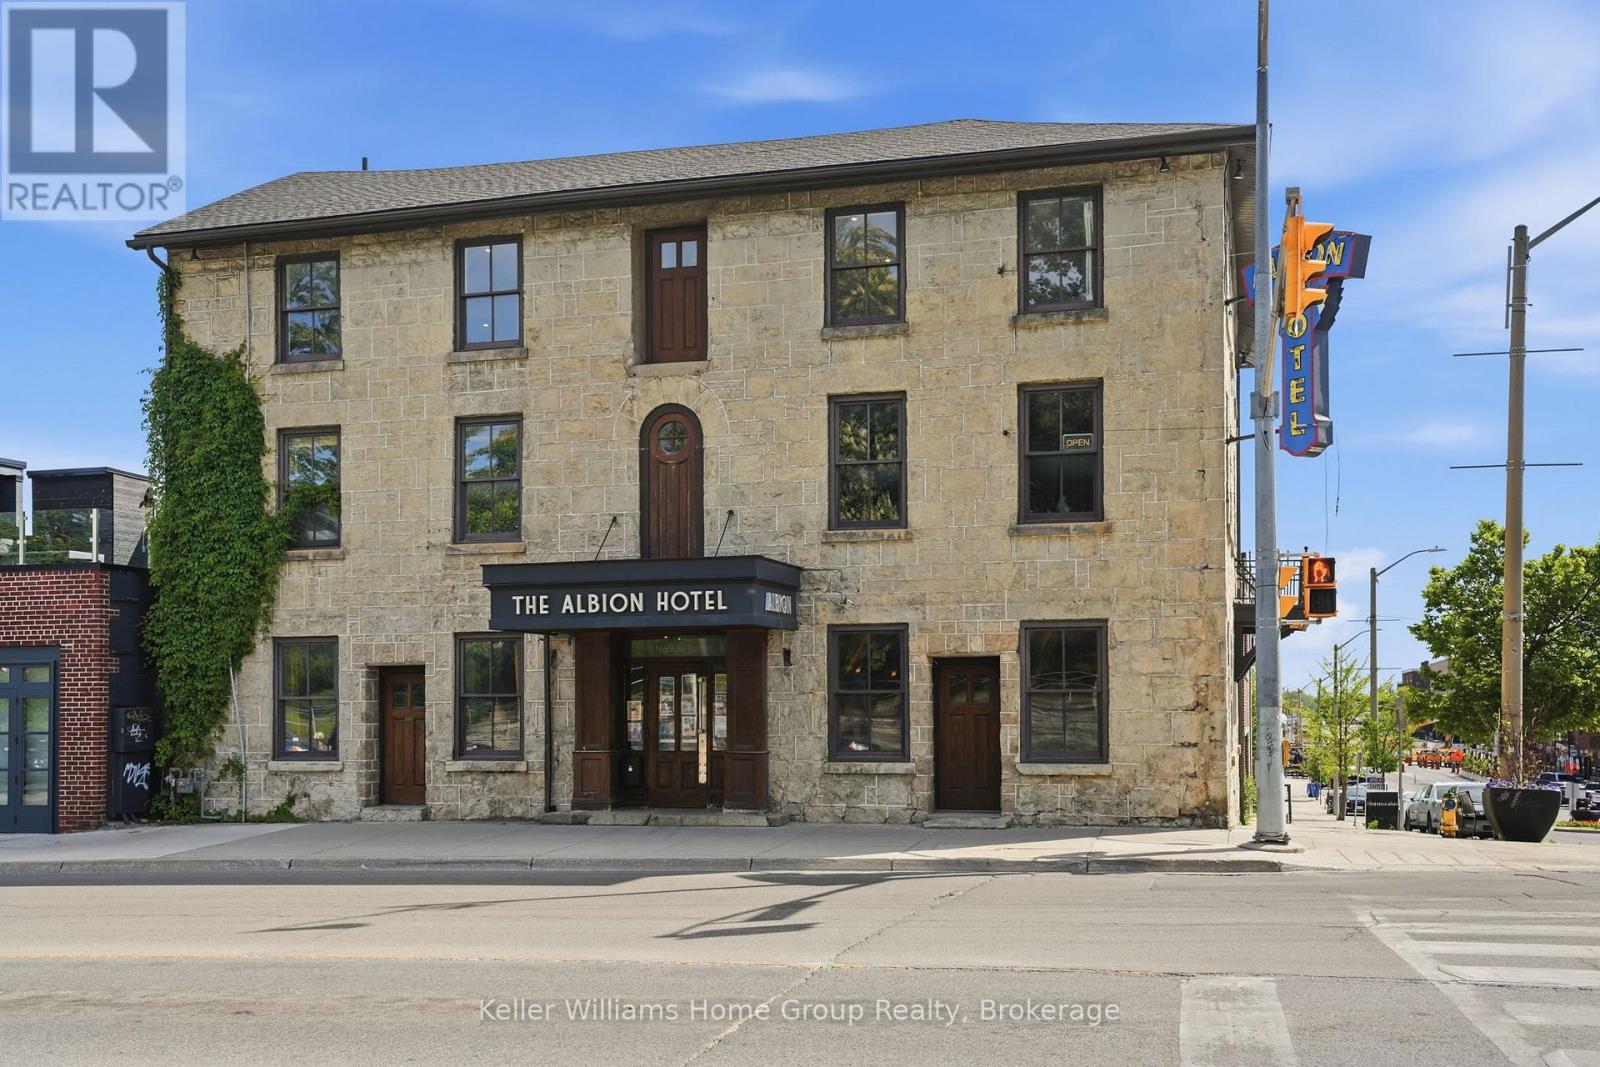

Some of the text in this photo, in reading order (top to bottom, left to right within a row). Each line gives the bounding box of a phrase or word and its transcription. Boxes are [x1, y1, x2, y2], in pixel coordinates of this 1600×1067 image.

[1286, 312, 1308, 437] OTEL
[1066, 438, 1090, 447] OPEN
[512, 590, 728, 615] THE ALBION HOTEL
